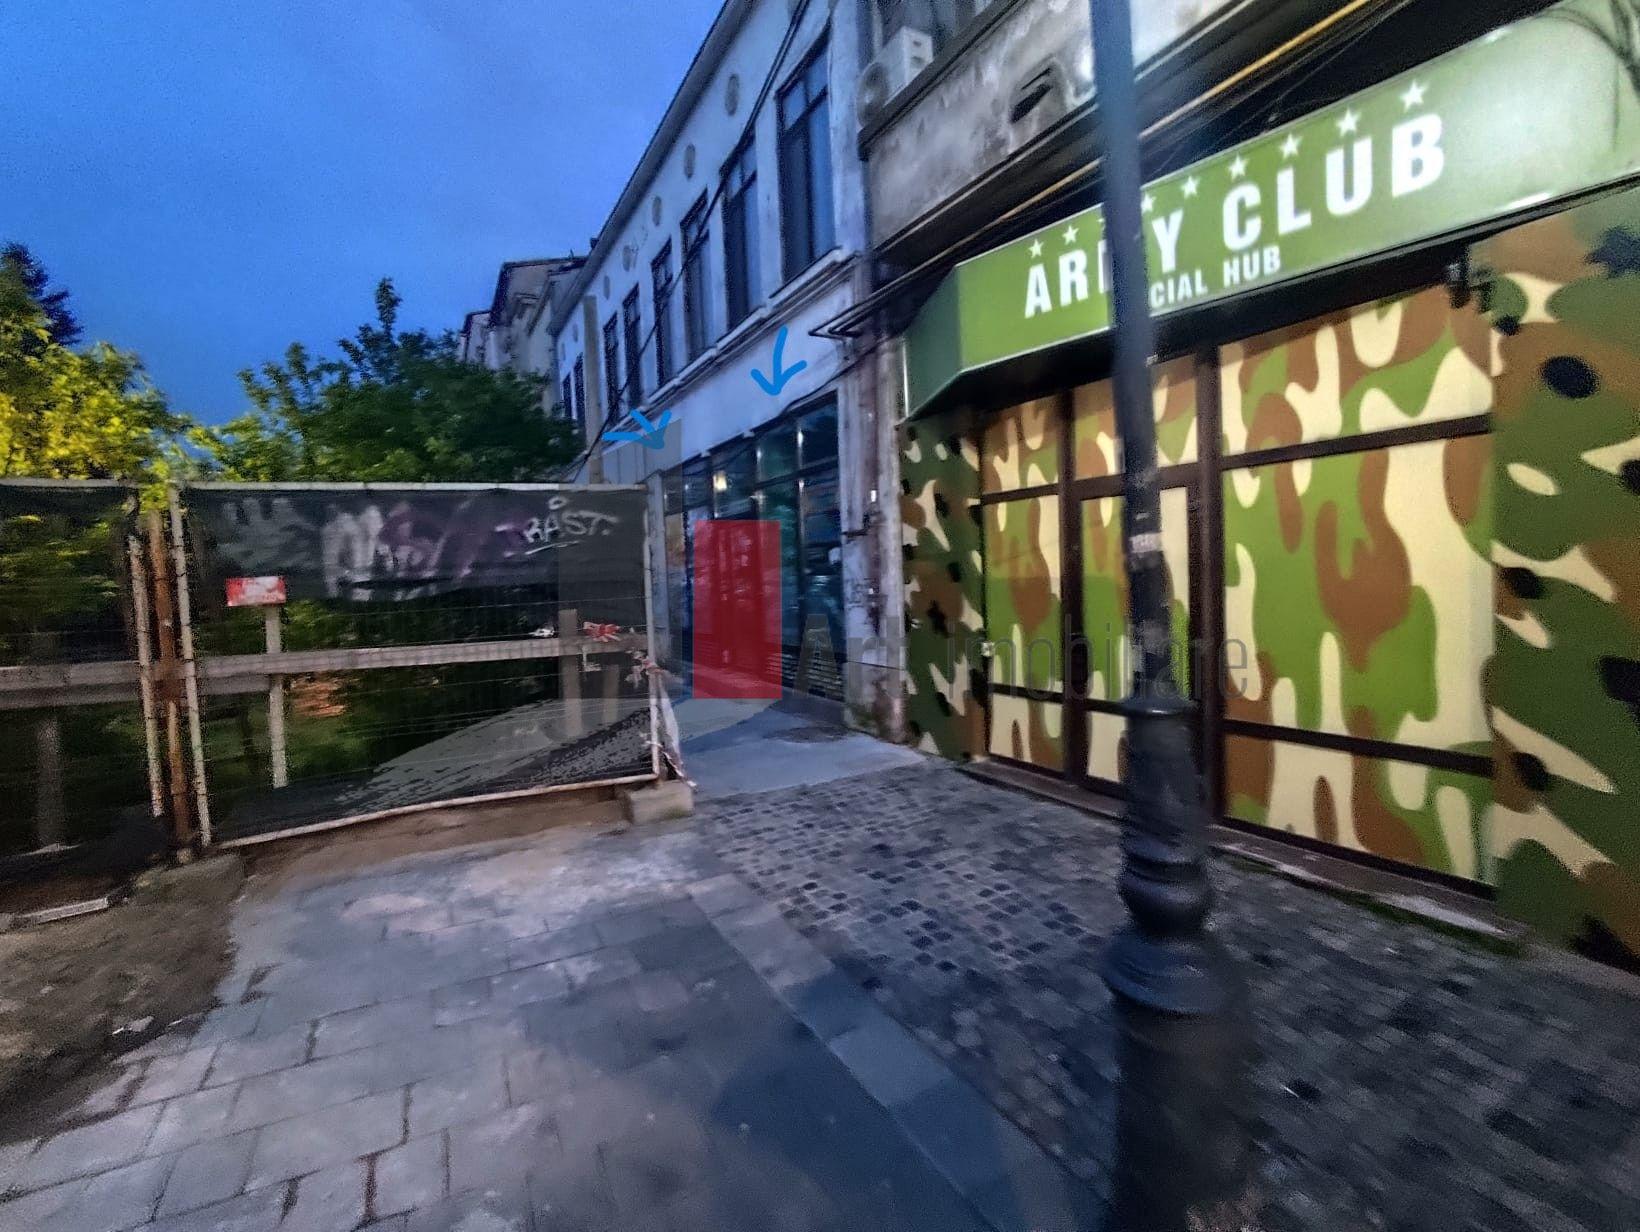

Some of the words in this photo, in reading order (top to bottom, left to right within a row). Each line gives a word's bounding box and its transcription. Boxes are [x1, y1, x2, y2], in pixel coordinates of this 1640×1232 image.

[1222, 113, 1444, 250] CLUB
[1149, 269, 1208, 308] CIAL
[1223, 245, 1281, 288] HUB
